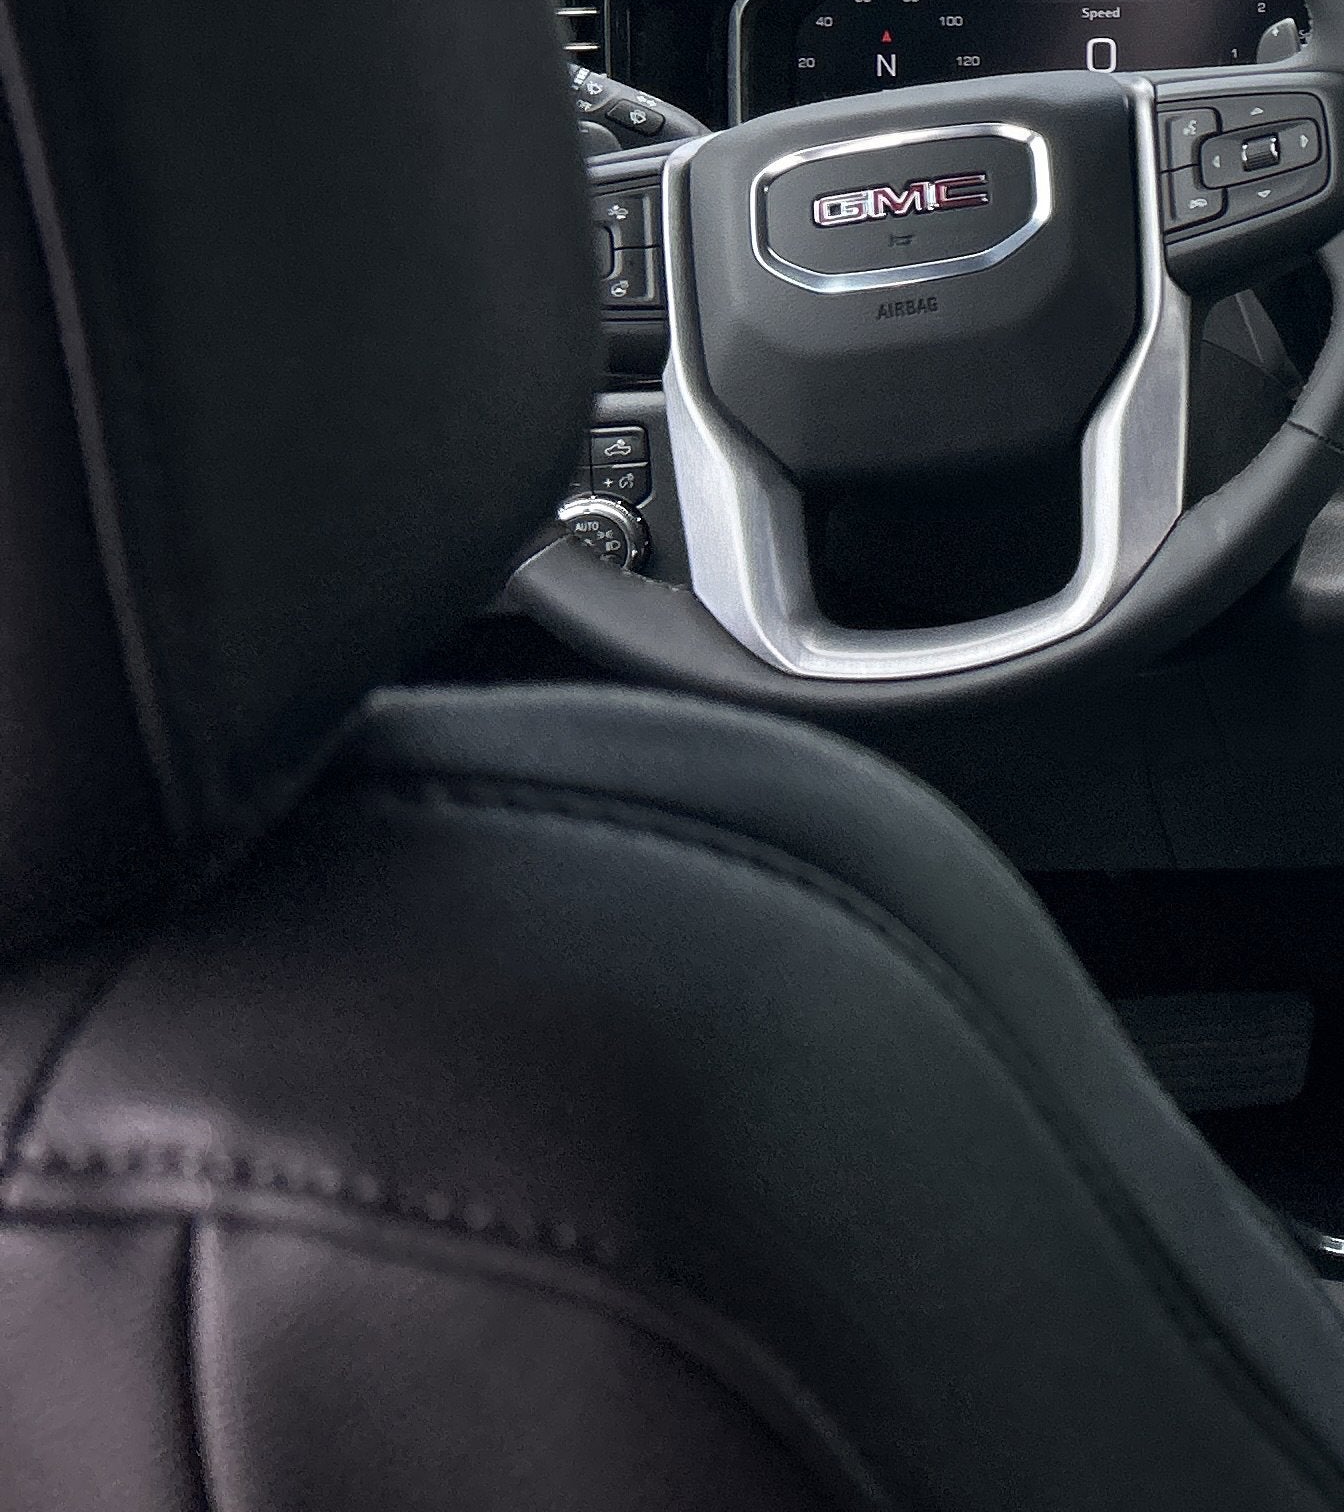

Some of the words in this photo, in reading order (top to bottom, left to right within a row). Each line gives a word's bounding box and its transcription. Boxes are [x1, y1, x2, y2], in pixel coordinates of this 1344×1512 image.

[1081, 6, 1121, 21] Speed
[1257, 2, 1266, 13] 2
[816, 16, 833, 28] 40
[939, 16, 964, 27] 100
[1087, 37, 1117, 74] 0
[1231, 48, 1238, 59] 1
[798, 58, 816, 68] 20
[876, 54, 896, 78] N
[956, 56, 981, 67] 120
[814, 174, 990, 227] GMC
[876, 296, 939, 320] AIRBAG
